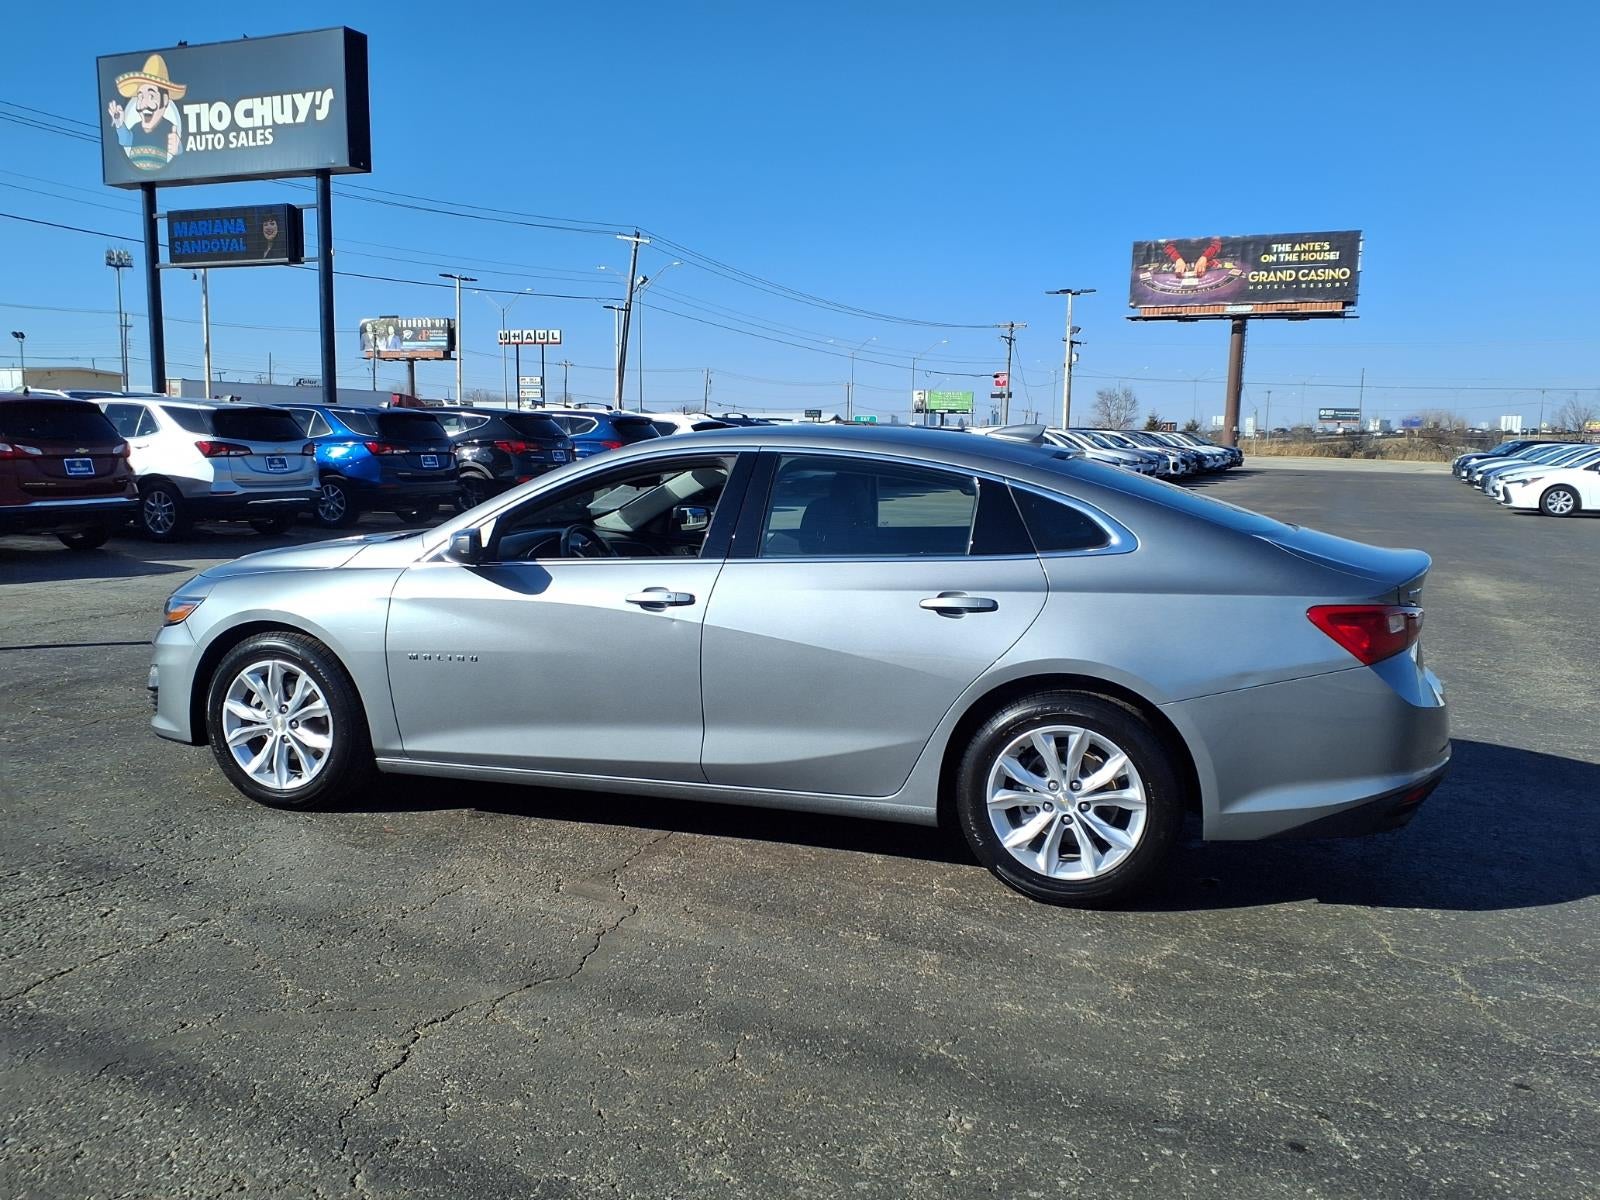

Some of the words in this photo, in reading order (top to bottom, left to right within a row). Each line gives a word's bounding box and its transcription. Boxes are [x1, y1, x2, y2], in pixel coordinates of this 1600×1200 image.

[183, 101, 232, 133] TIO
[233, 88, 334, 128] CHUY'S
[186, 133, 225, 152] AUTO
[228, 128, 274, 149] SALES
[174, 218, 246, 237] MARIANA
[175, 238, 246, 254] SANDOVAL
[1272, 244, 1292, 252] THE
[1293, 242, 1330, 251] ANTE'S
[1260, 254, 1277, 263] ON
[1278, 252, 1299, 262] THE
[1300, 251, 1340, 261] HOUSE!
[1248, 270, 1296, 283] GRAND
[1298, 267, 1351, 281] CASINO
[1301, 281, 1350, 289] RESORT
[407, 653, 479, 662] MALIBU
